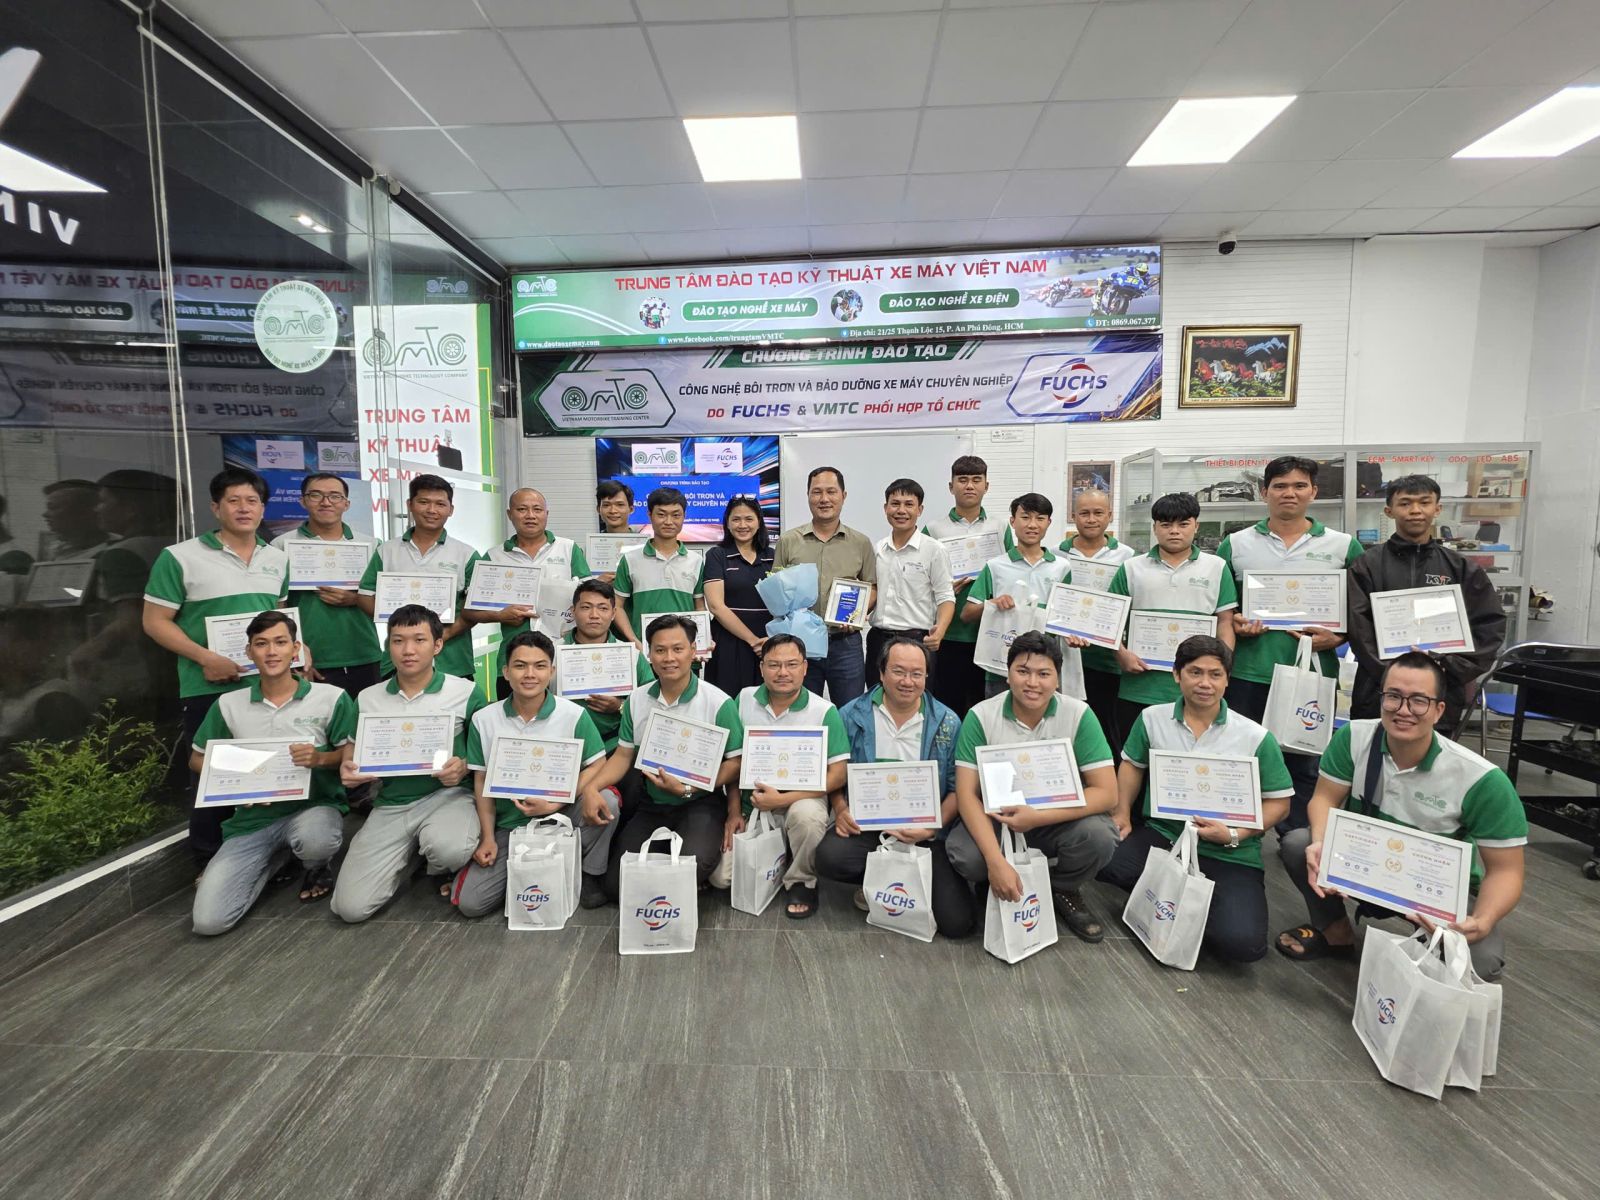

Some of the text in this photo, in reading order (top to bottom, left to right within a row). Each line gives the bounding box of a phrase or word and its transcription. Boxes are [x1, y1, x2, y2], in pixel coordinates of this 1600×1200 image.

[615, 259, 1047, 290] TRUNG TÂM ĐÀO TẠO KỸ THUẬT XE MÁY VIỆT NAM
[889, 291, 1009, 309] ĐÀO TẠO NGHỀ XE ĐIỆN
[692, 301, 808, 317] ĐÀO TẠO NGHỀ XE MÁY
[850, 329, 861, 337] Địa
[877, 327, 896, 336] 21/25
[897, 326, 919, 336] Thạnh
[920, 325, 934, 335] Lộc
[935, 325, 946, 335] 15,
[946, 325, 954, 333] P.
[955, 324, 966, 332] An
[967, 323, 981, 331] Phú
[1004, 322, 1024, 330] HCM
[1095, 317, 1156, 327] ĐT: 0869.067.377
[871, 344, 909, 359] ĐÀO
[914, 344, 948, 359] TẠO
[679, 373, 1013, 396] CÔNG NGHỆ BÔI TRƠN VÀ BẢO DƯỠNG XE MÁY CHUYÊN NGHIỆP
[1040, 375, 1108, 391] FUCHS
[365, 405, 470, 423] TRUNG TÂM
[707, 396, 982, 418] DO FUCHS & VMTC PHỐI HỢP TỔ CHỨC
[367, 435, 389, 453] KỸ
[1448, 455, 1467, 463] ODO
[516, 893, 550, 902] FUCHS
[875, 891, 915, 909] FUCHS
[636, 907, 680, 919] FUCHS
[1014, 905, 1040, 922] FUCH
[1154, 900, 1176, 920] FUCHS
[1377, 998, 1396, 1024] FUCHS
